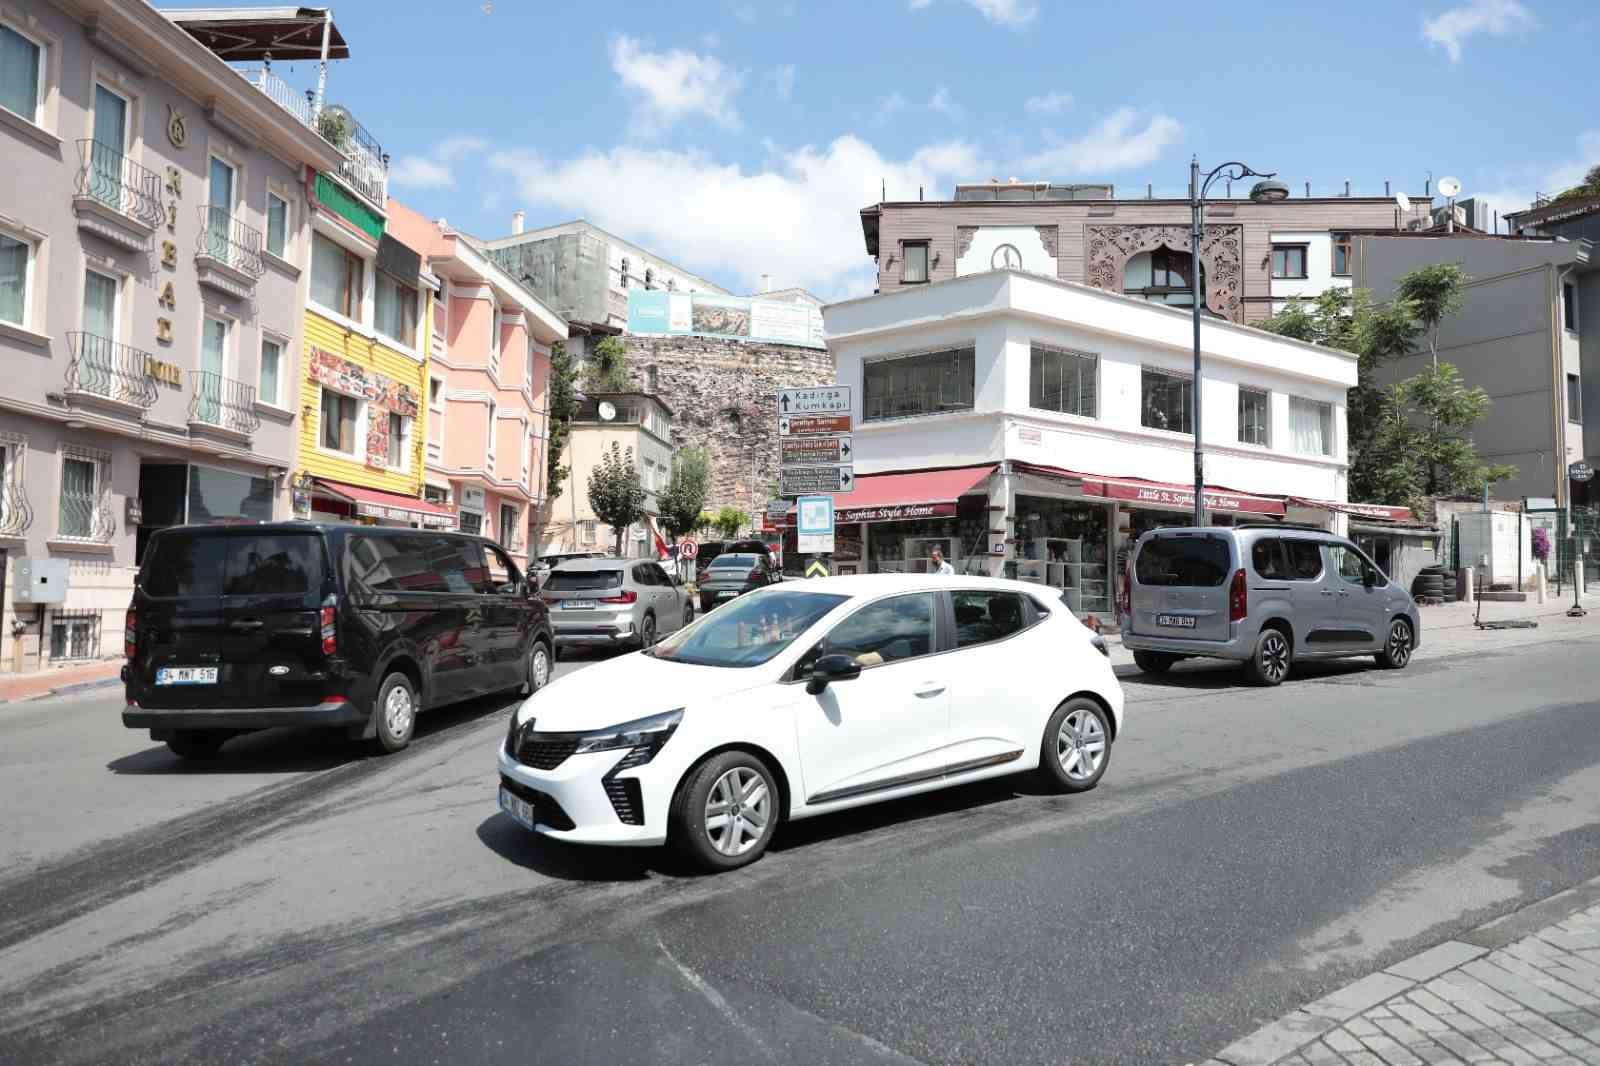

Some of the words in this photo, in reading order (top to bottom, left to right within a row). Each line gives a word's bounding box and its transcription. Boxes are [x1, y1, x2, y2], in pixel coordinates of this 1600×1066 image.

[846, 509, 876, 522] Sophia
[879, 507, 902, 521] Style
[904, 506, 934, 516] Home
